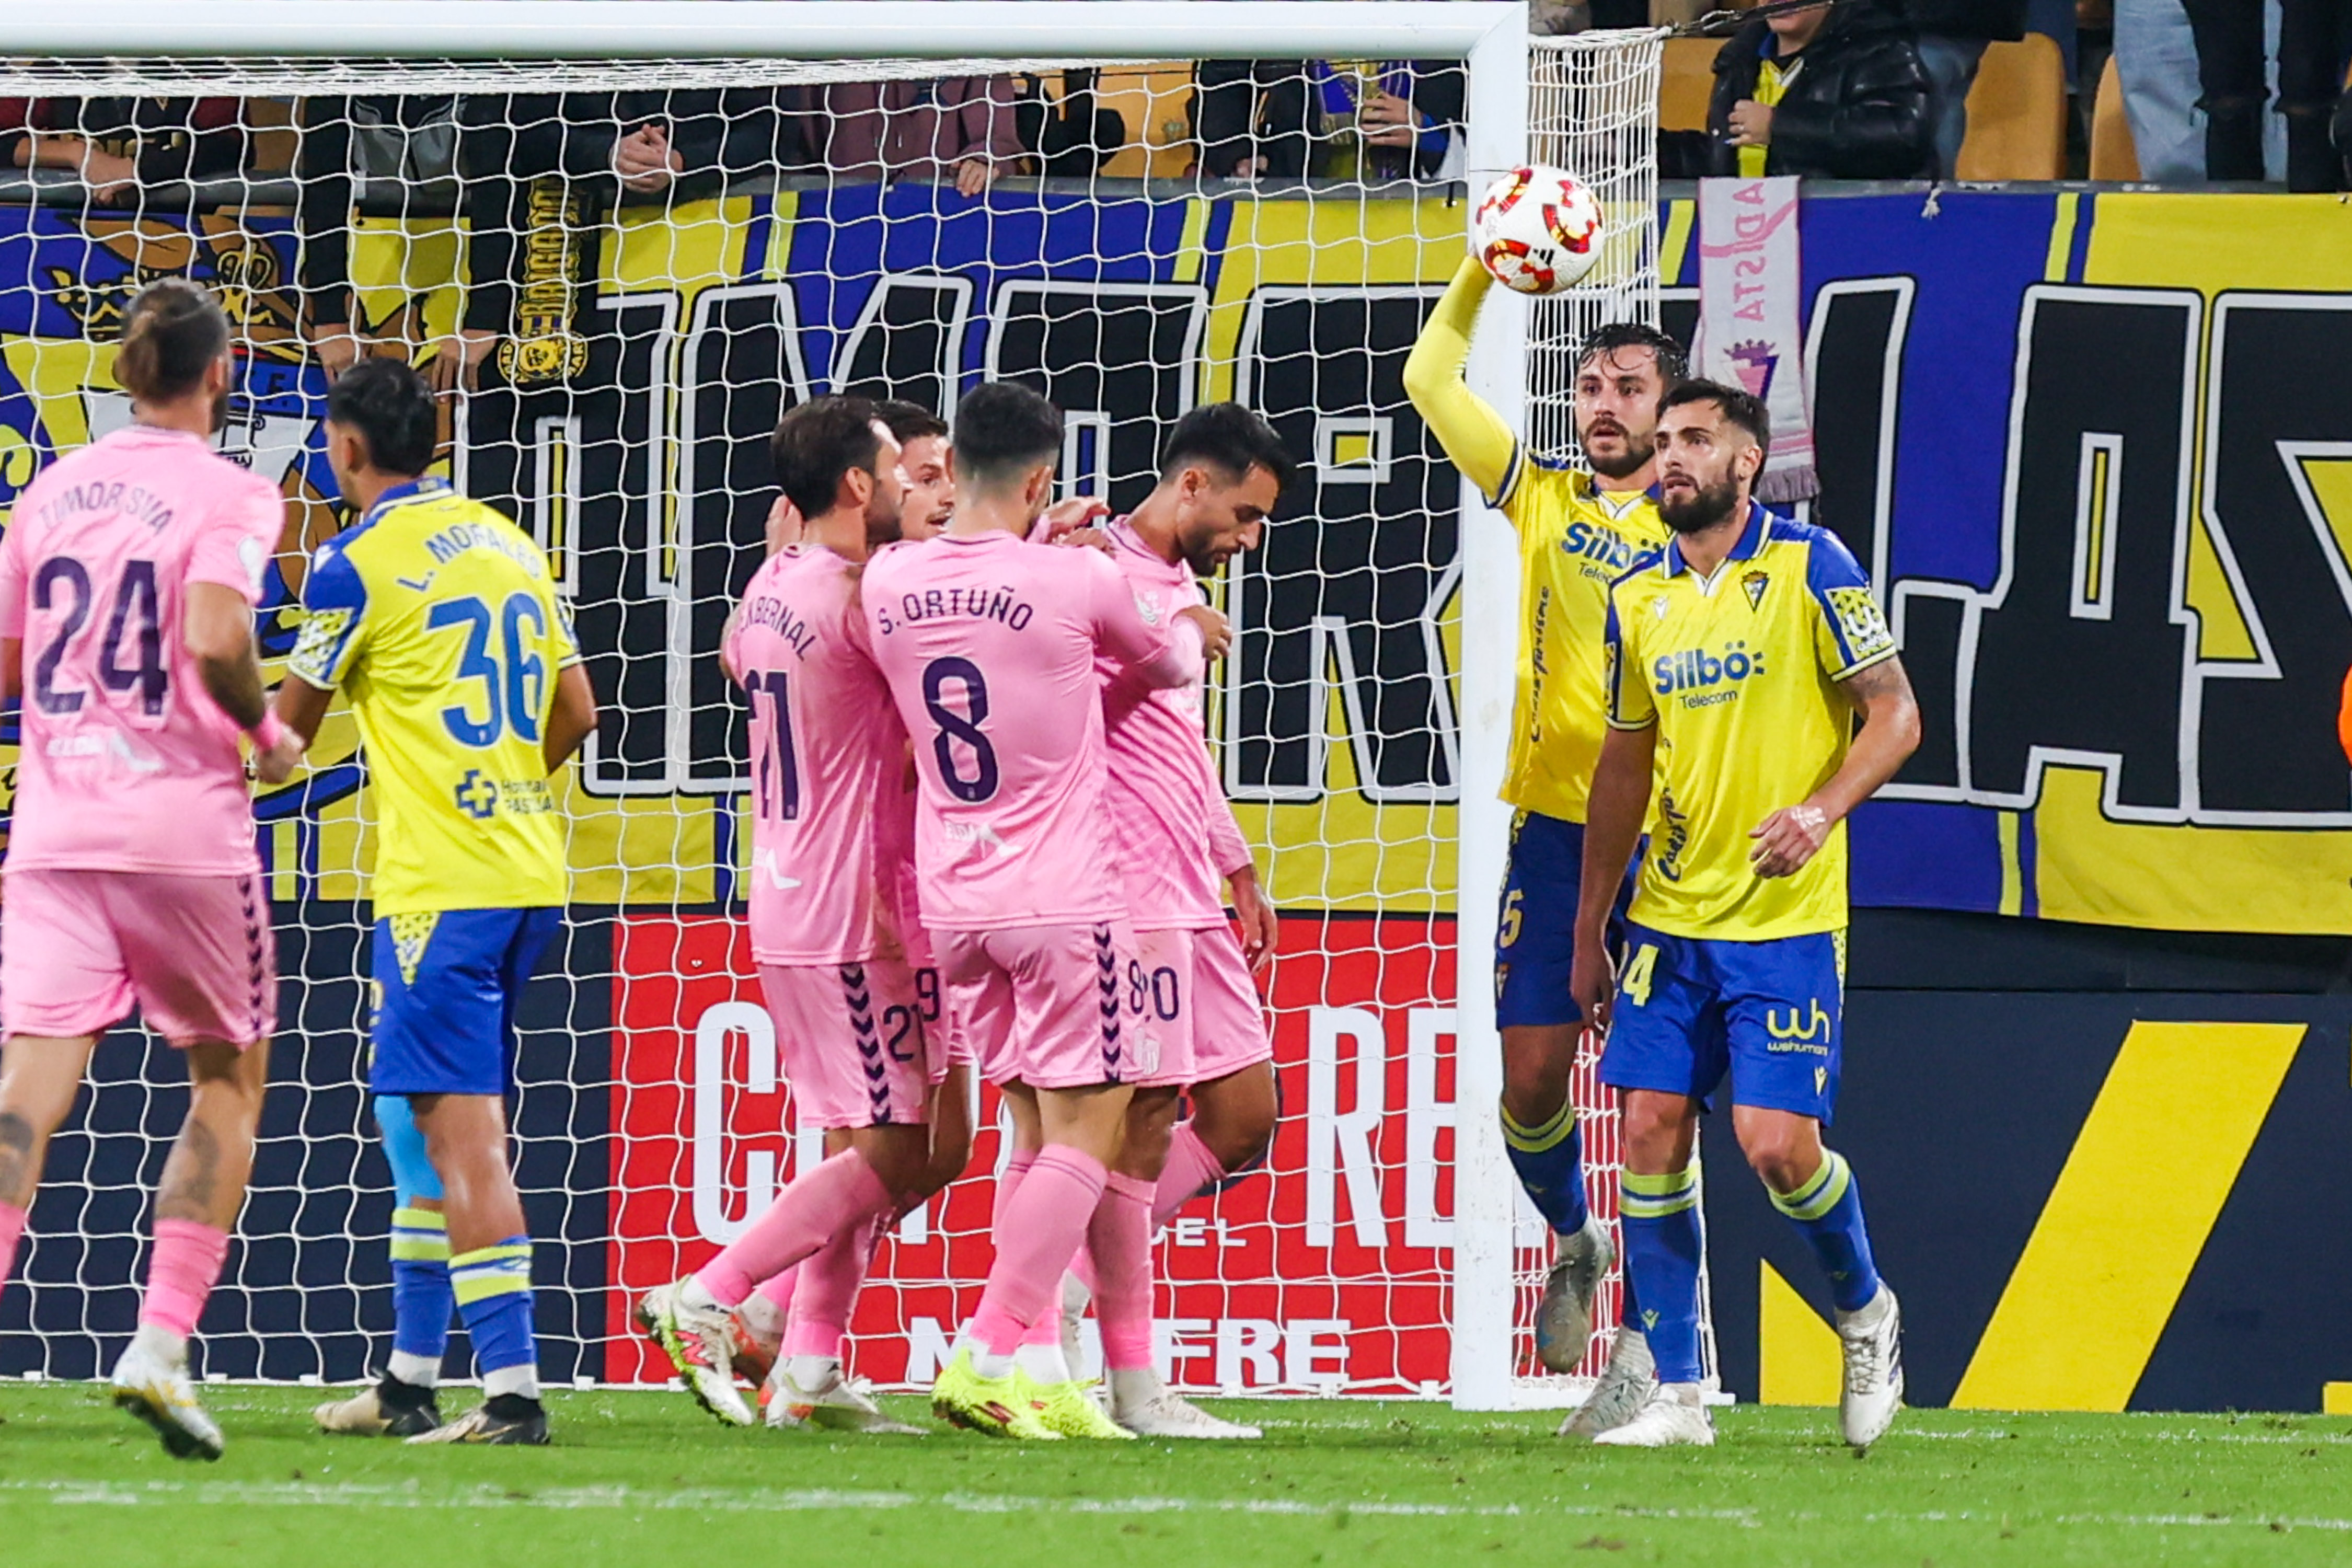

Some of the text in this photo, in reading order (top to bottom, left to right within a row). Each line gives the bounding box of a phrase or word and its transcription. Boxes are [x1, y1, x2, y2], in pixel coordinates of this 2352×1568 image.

[397, 571, 435, 592] L.
[878, 586, 1034, 636] S. ORTUÑO
[31, 556, 169, 719] 24
[423, 591, 546, 748] 36
[1655, 641, 1750, 695] Silbö
[1678, 688, 1738, 708] Telecom
[923, 655, 998, 805] 8
[1768, 998, 1830, 1043] wh
